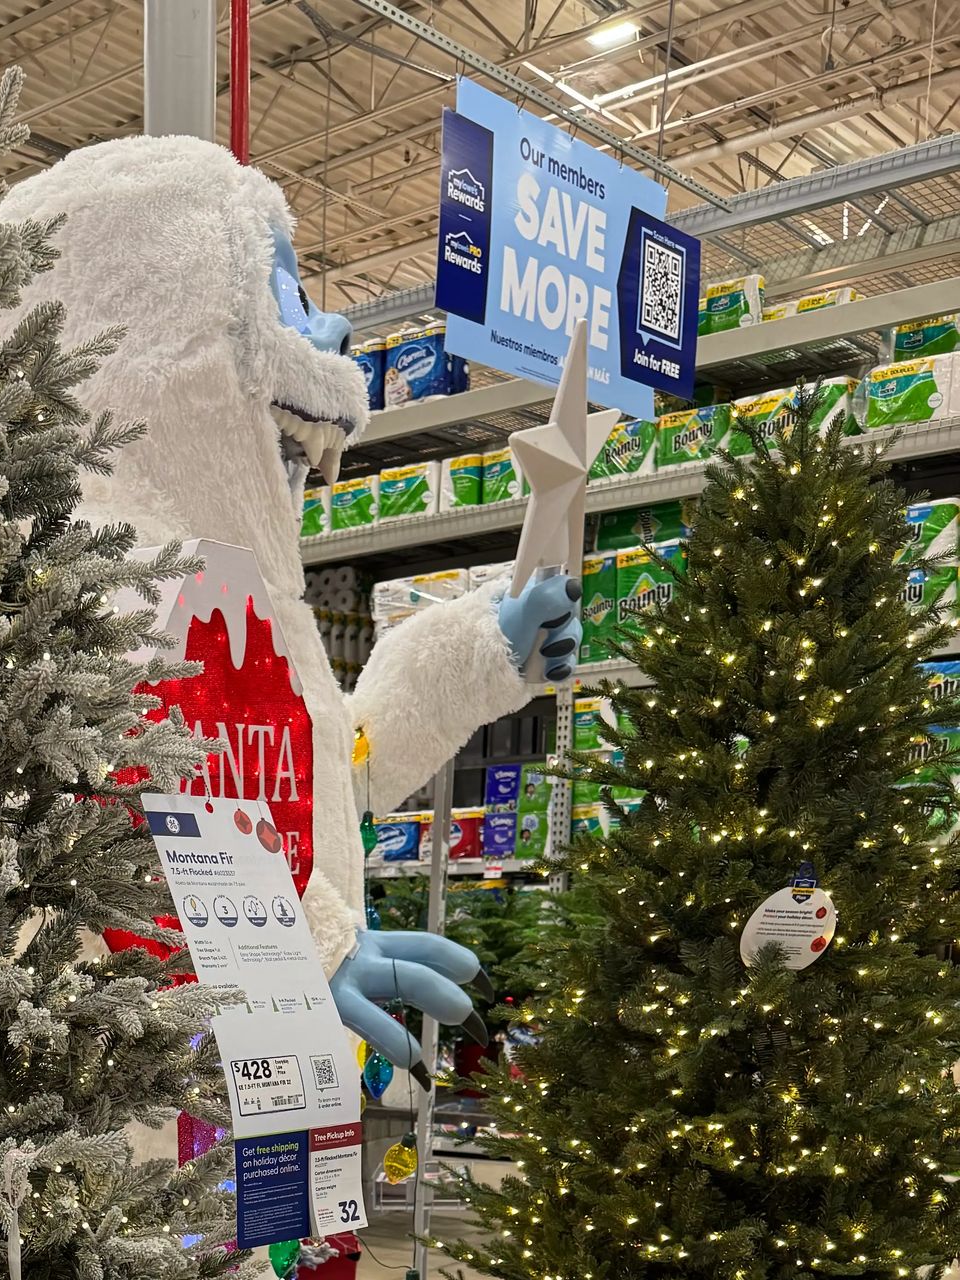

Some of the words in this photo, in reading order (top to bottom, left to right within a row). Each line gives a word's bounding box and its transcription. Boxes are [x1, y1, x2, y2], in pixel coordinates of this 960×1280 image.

[520, 137, 545, 168] Our
[548, 156, 605, 200] members
[447, 181, 485, 213] Rewards
[514, 171, 607, 273] SAVE
[444, 245, 482, 274] Rewards
[500, 245, 612, 351] MORE
[491, 329, 522, 353] Nuestros
[523, 344, 559, 367] miembros
[633, 348, 649, 367] Join
[649, 352, 661, 370] for
[661, 359, 680, 379] FREE
[604, 437, 641, 464] Bounty
[672, 422, 713, 453] Bounty
[618, 583, 673, 624] Bounty
[166, 850, 219, 865] Montana
[219, 851, 233, 865] Fir
[171, 867, 188, 876] 7.5-ft
[189, 867, 213, 876] Flocked
[242, 1147, 255, 1157] Get
[256, 1145, 270, 1155] free
[271, 1141, 299, 1153] shipping
[314, 1134, 326, 1142] Tree
[326, 1130, 344, 1140] Pickup
[344, 1129, 355, 1138] Info
[243, 1160, 252, 1168] on
[253, 1155, 278, 1167] holiday
[278, 1153, 297, 1163] décor
[243, 1165, 278, 1181] purchased
[338, 1199, 360, 1223] 32
